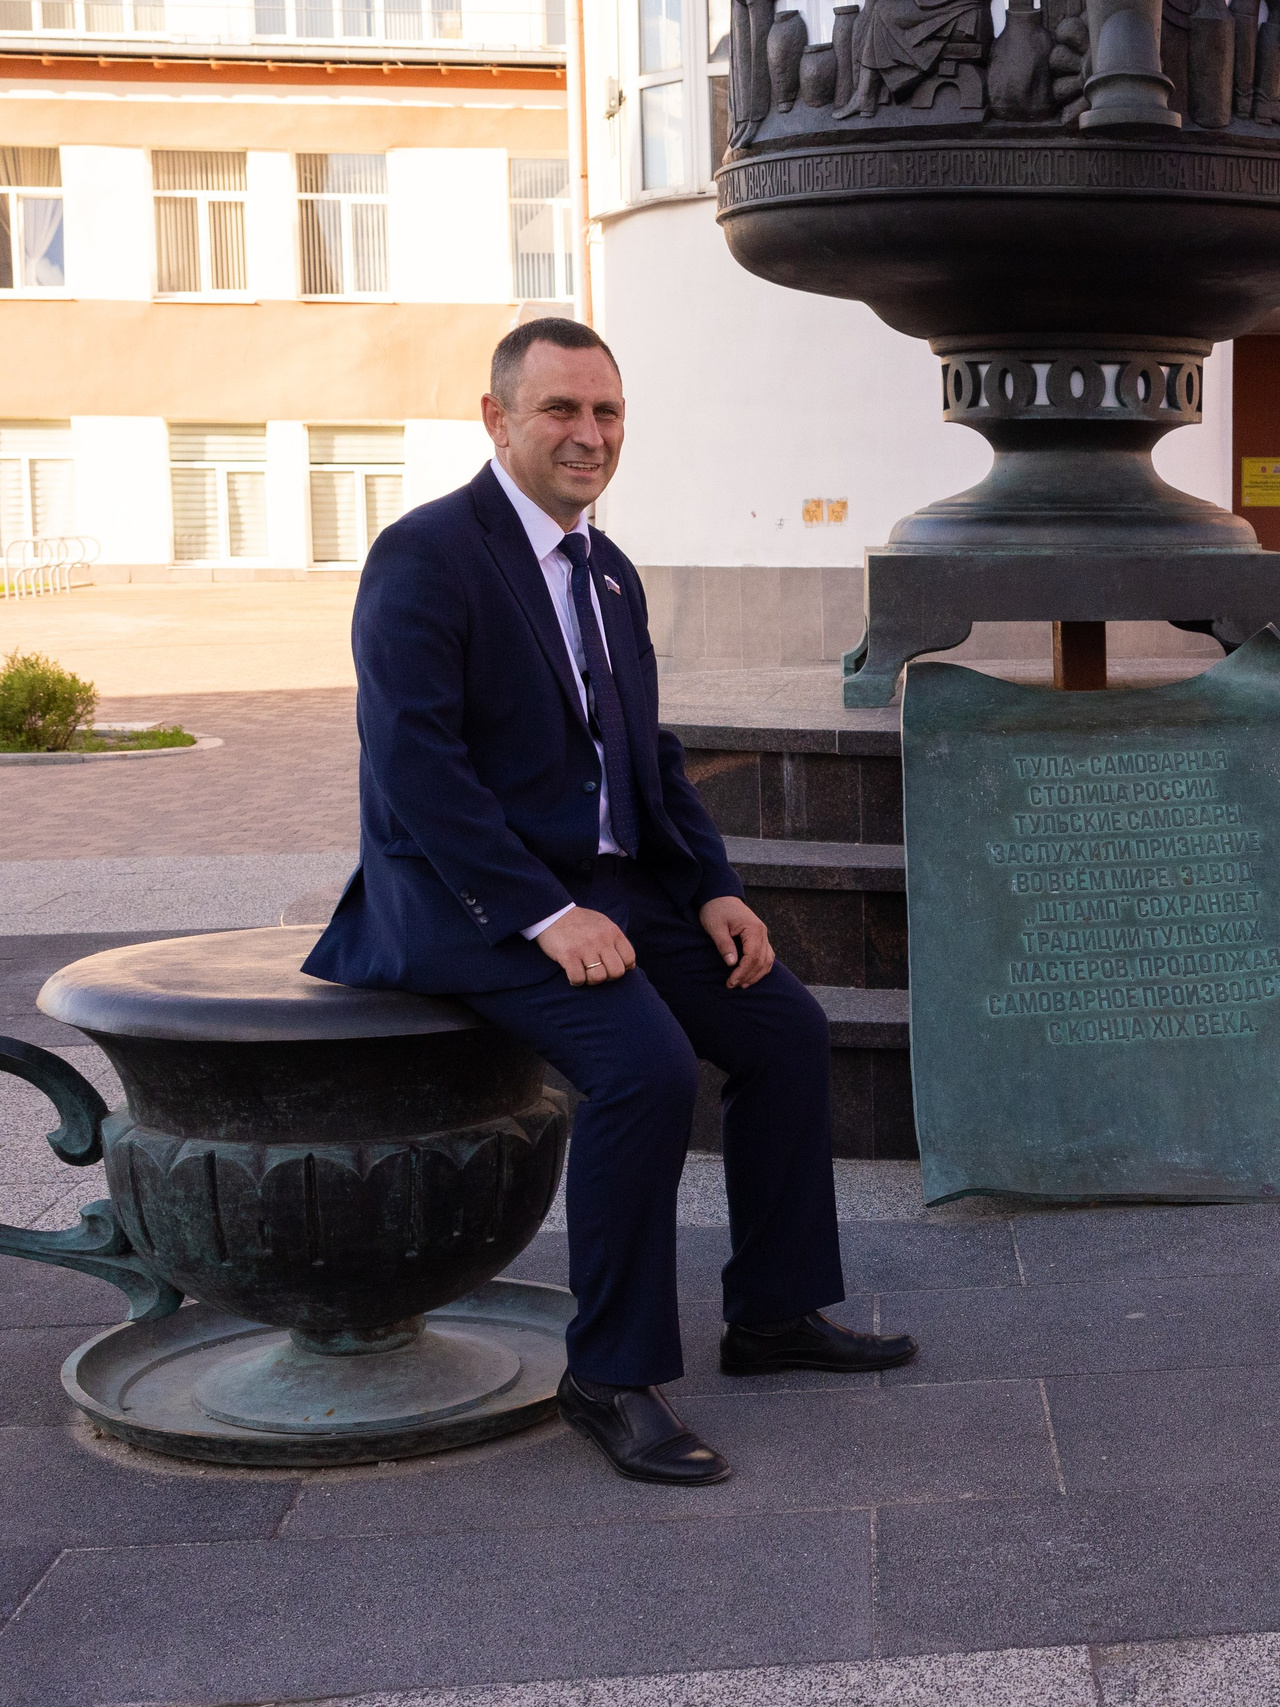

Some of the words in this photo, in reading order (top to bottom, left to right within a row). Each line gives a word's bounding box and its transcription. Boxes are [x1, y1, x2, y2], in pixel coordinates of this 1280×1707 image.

[1194, 154, 1219, 192] НА
[1015, 757, 1075, 778] ТУЛА
[1090, 750, 1228, 776] САМОВАРНАЯ
[1030, 783, 1130, 806] СТОЛИЦА
[1132, 778, 1219, 802] РОССИИ.
[1014, 811, 1124, 835] ТУЛЬСКИЕ
[1127, 804, 1244, 831] САМОВАРЫ
[993, 839, 1132, 864] ЗАСЛУЖИЛИ
[1135, 831, 1261, 860] ПРИЗНАНИЕ
[1016, 872, 1044, 893] ВО
[1048, 867, 1107, 892] ВСЁМ
[1111, 867, 1175, 889] МИРЕ.
[1181, 861, 1255, 886] ЗАВОД
[1136, 890, 1260, 918] СОХРАНЯЕТ
[1022, 927, 1142, 954] ТРАДИЦИИ
[1145, 920, 1263, 947] ТУЛЬСКИХ
[1010, 958, 1135, 984] МАСТЕРОВ,
[1138, 948, 1280, 978] ПРОДОЛЖАЯ
[988, 987, 1139, 1016] САМОВАРНОЕ
[1049, 1021, 1063, 1044] С
[1067, 1017, 1145, 1042] КОНЦА
[1194, 1010, 1260, 1036] ВЕКА.
